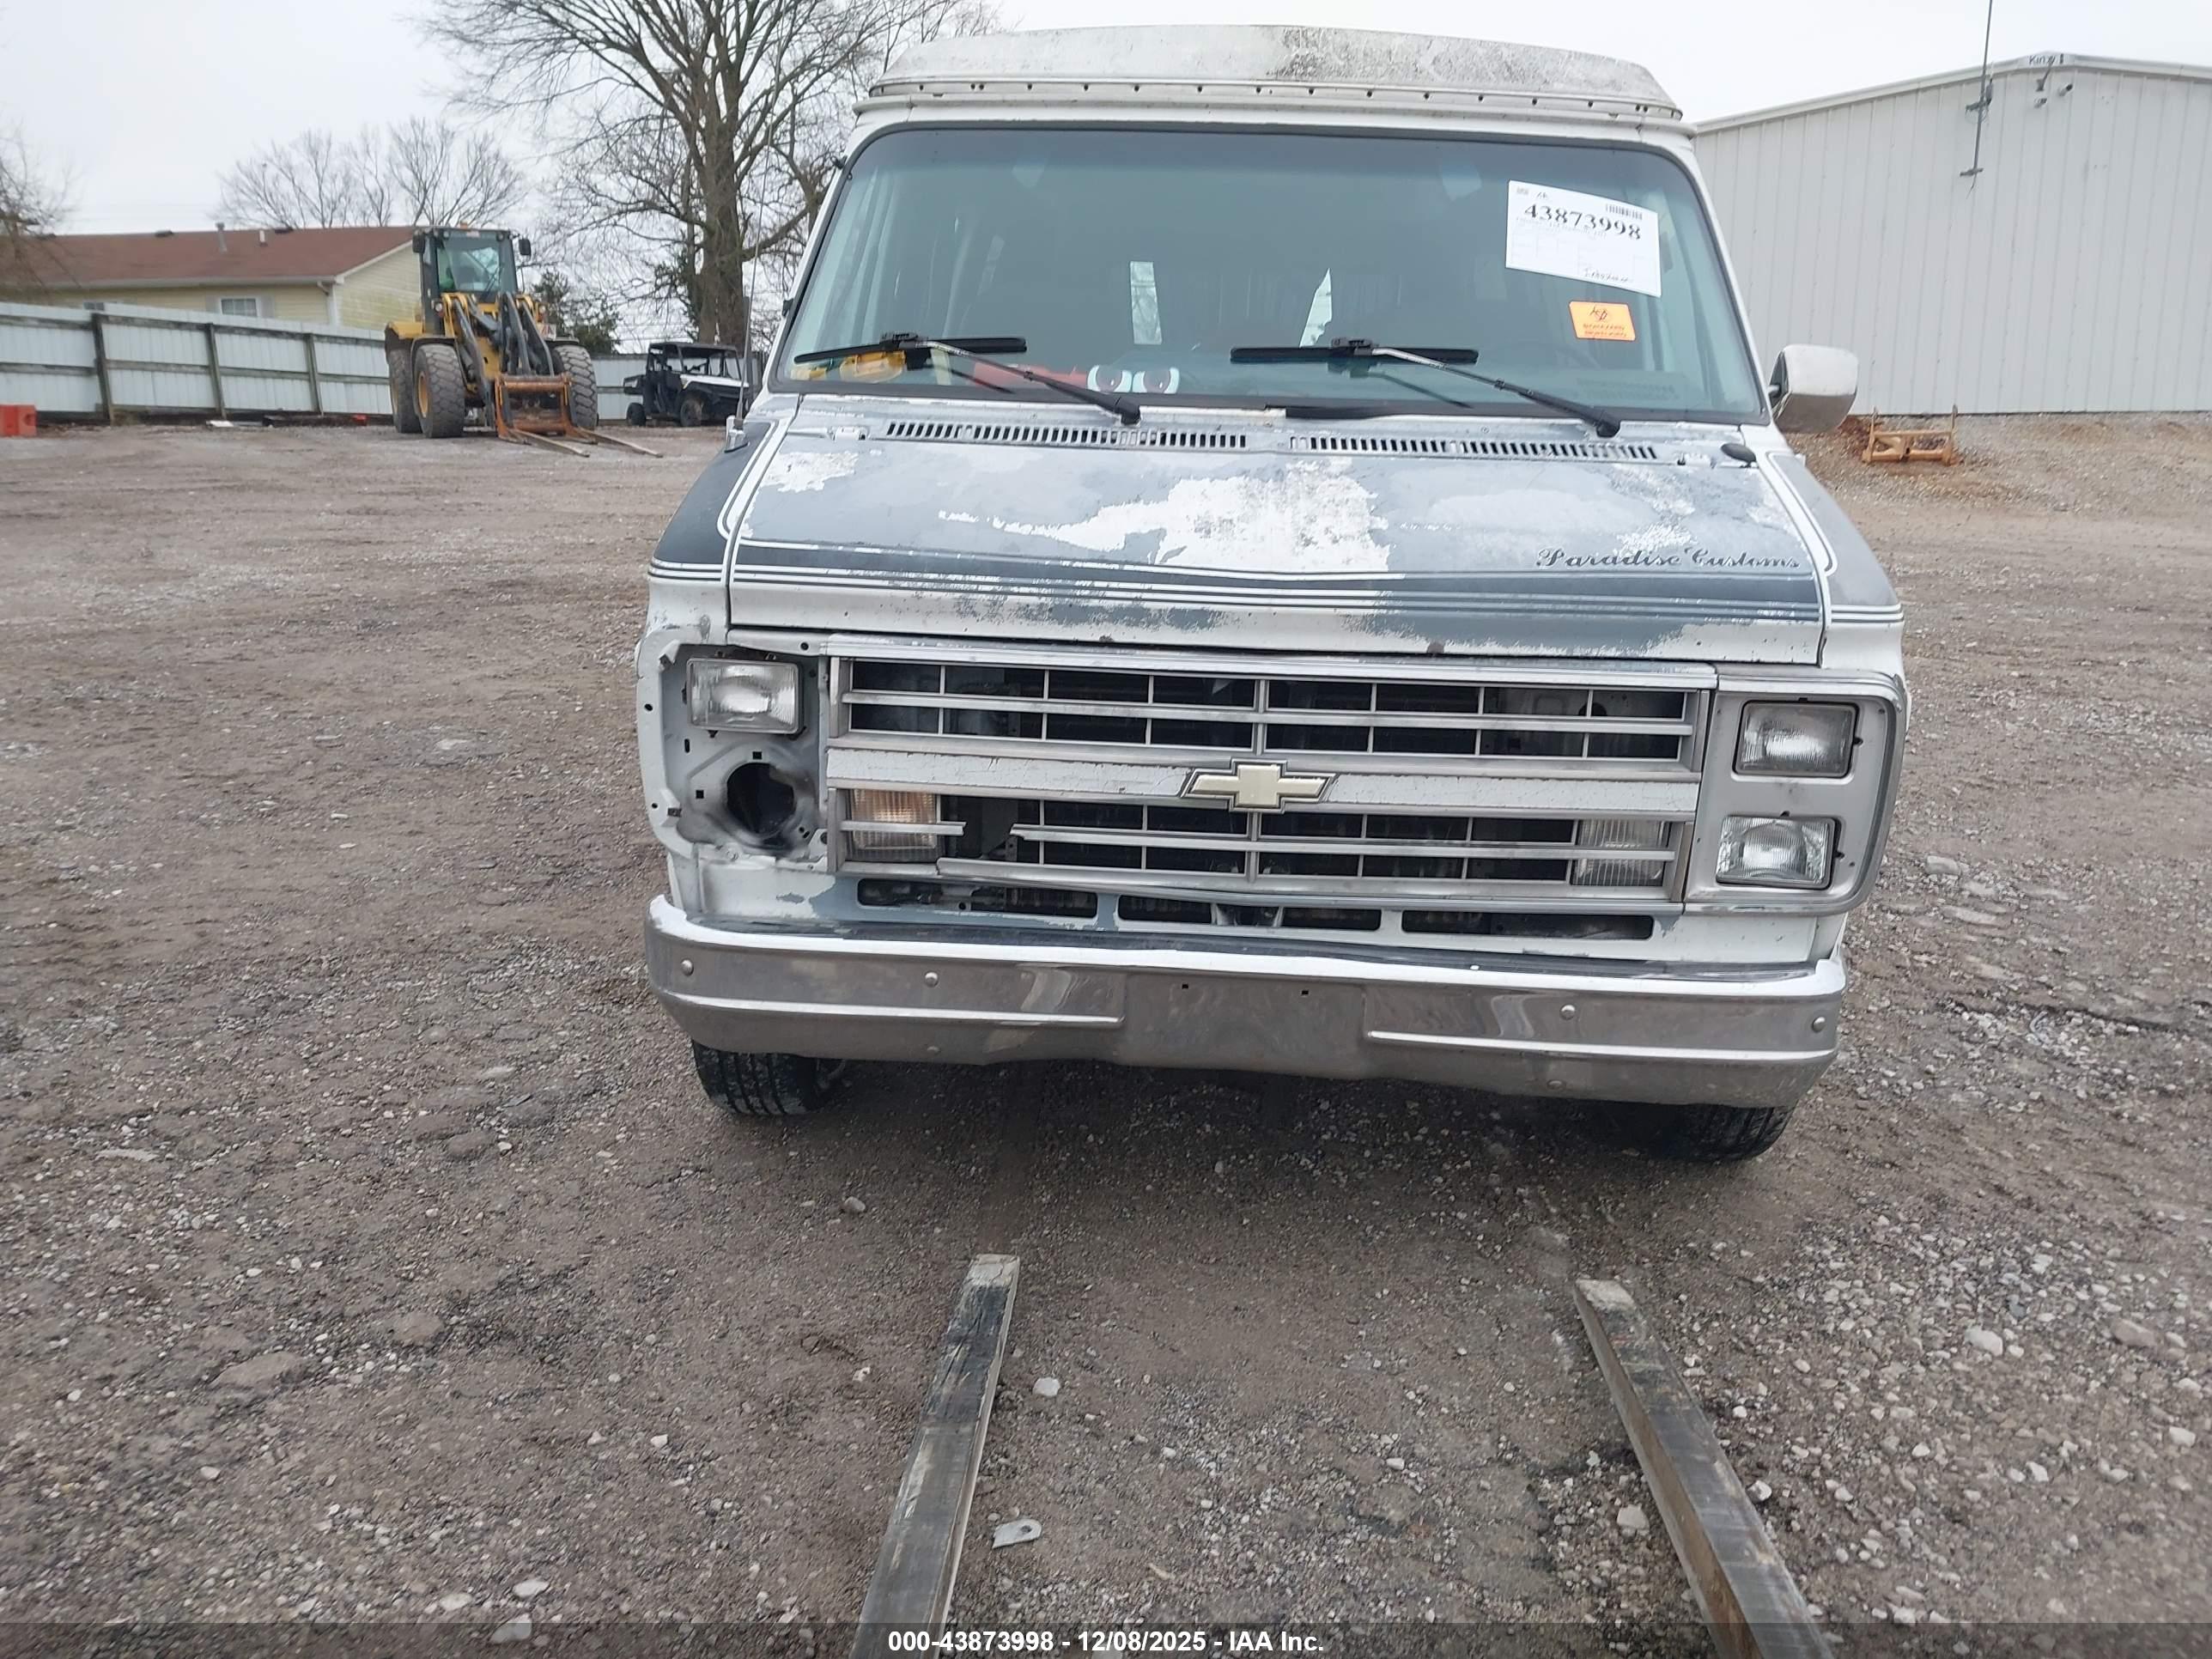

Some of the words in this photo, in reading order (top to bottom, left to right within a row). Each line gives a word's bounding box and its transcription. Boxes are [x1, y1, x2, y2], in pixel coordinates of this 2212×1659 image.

[1524, 204, 1641, 240] 43873998
[1535, 547, 1680, 568] Paradise
[1684, 546, 1801, 568] Customs
